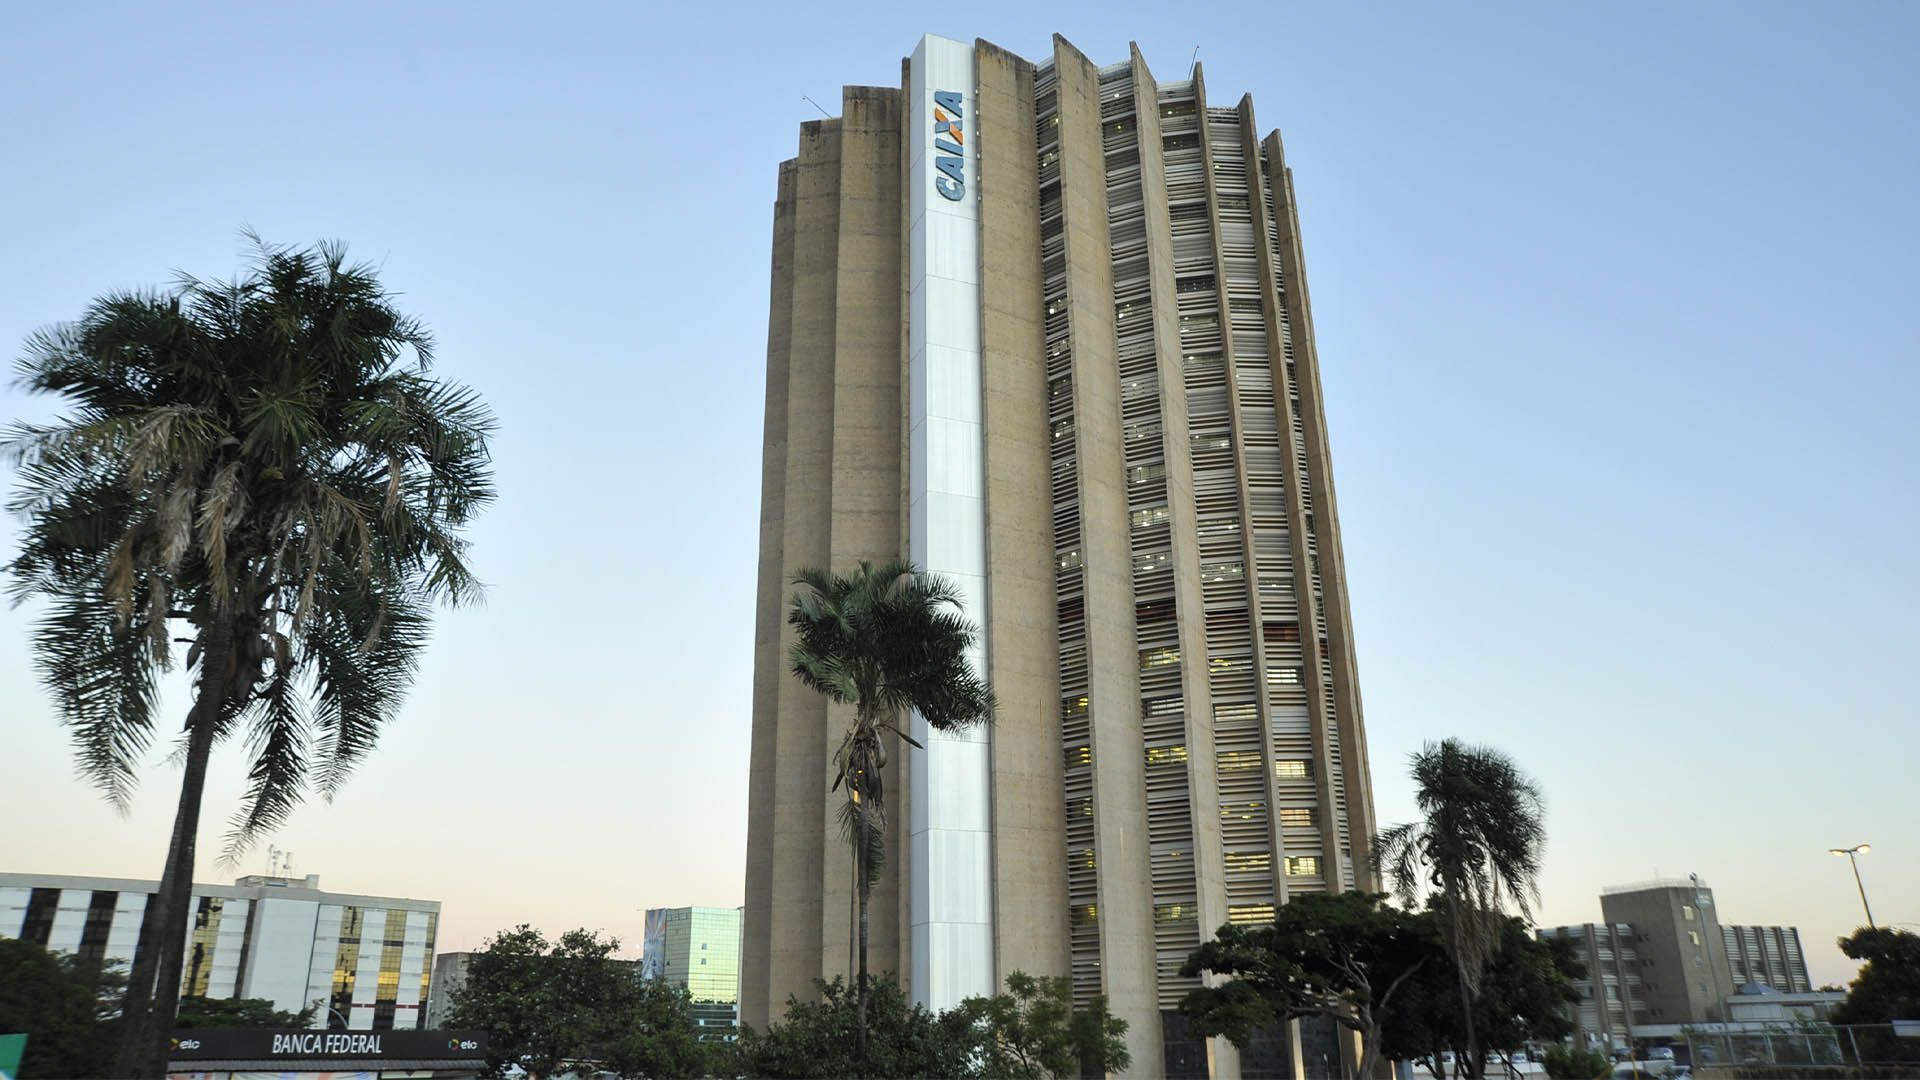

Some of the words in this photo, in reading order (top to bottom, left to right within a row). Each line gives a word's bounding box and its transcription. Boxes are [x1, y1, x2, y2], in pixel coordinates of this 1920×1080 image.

[934, 91, 966, 201] CAIXA
[272, 1034, 322, 1053] BANCA
[325, 1034, 382, 1053] FEDERAL
